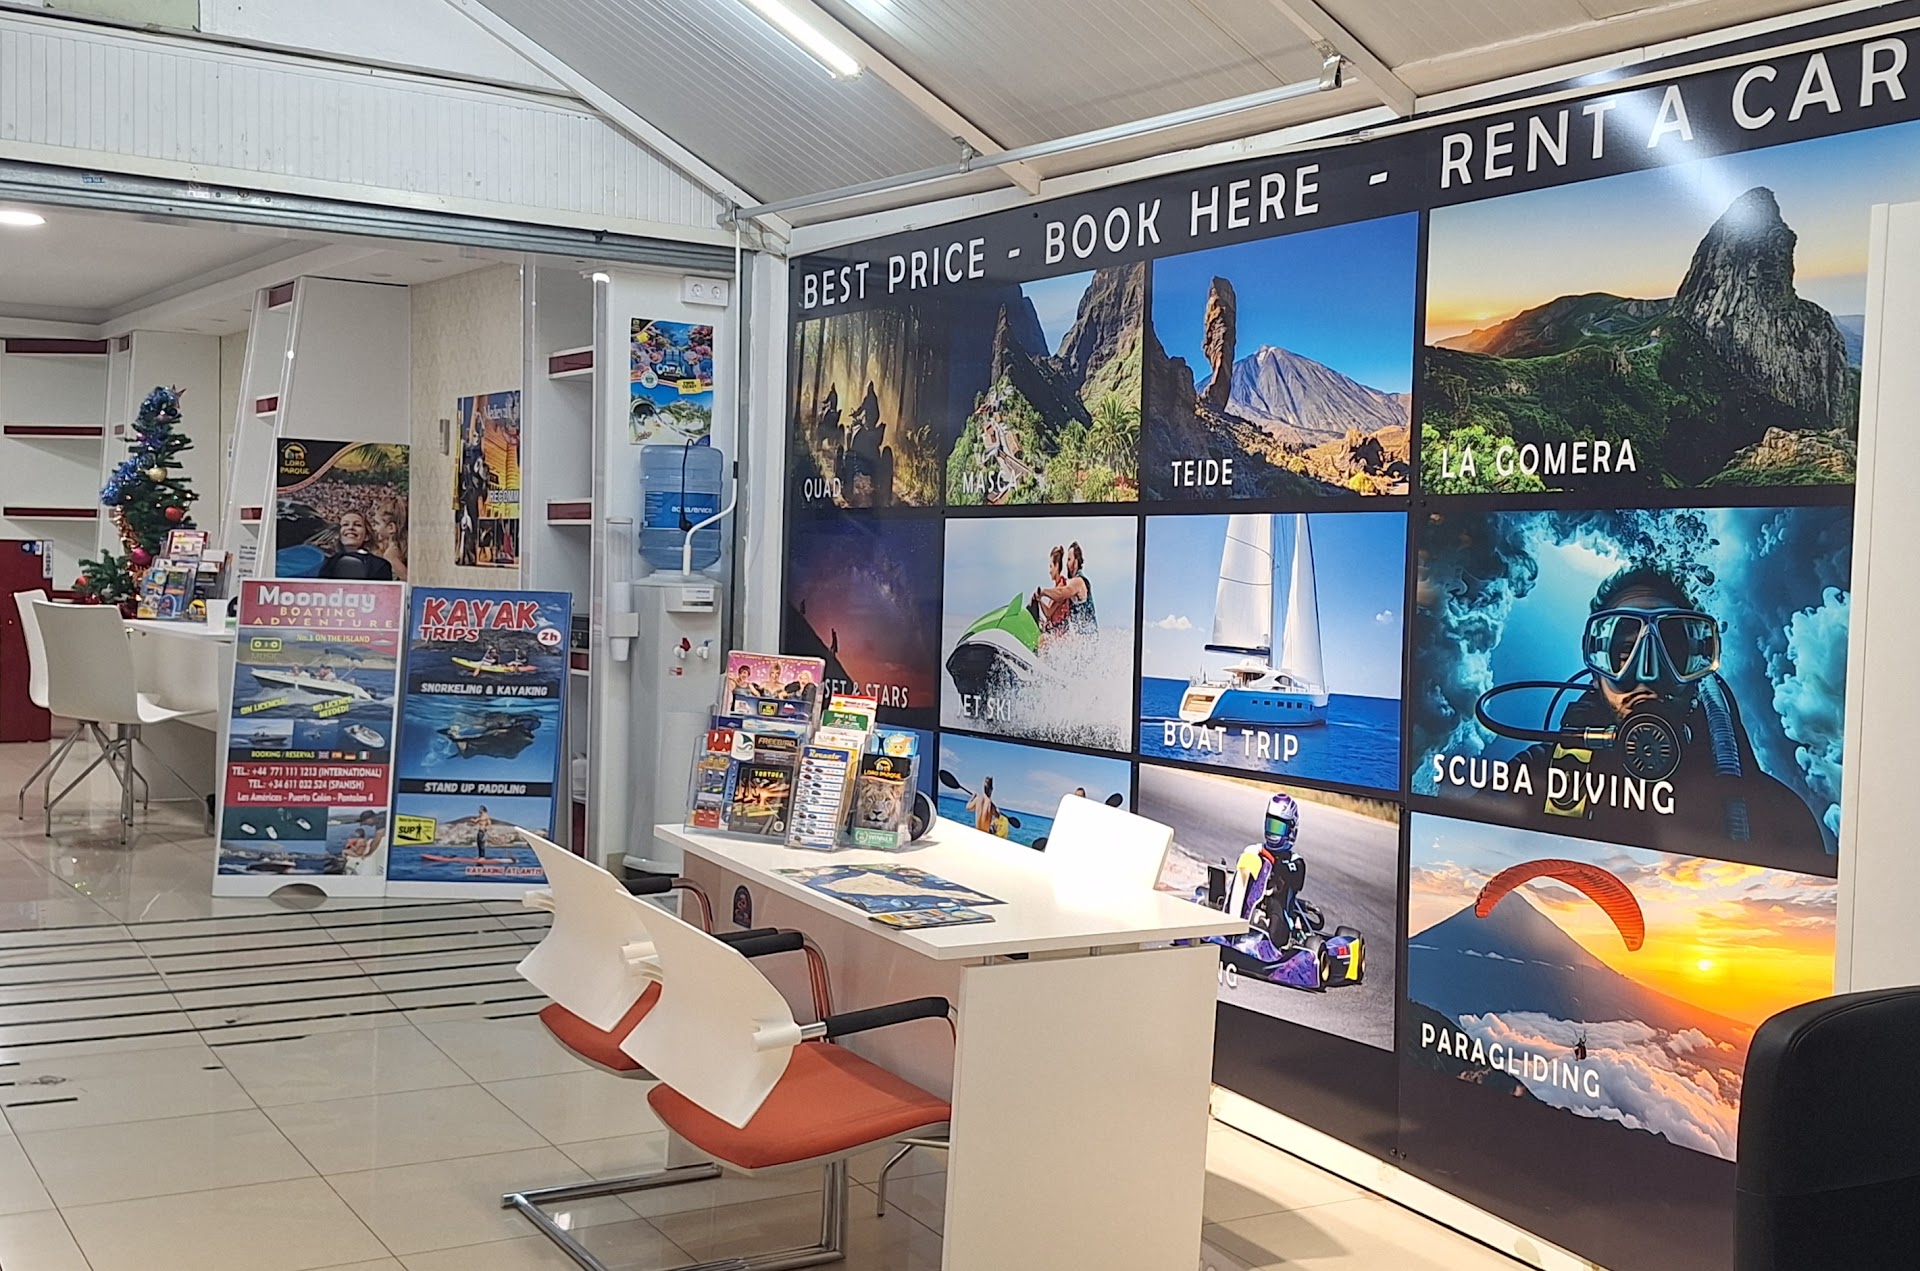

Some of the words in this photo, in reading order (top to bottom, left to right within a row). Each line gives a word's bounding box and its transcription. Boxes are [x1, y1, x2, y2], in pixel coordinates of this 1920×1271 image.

[804, 261, 868, 309] BEST
[888, 238, 985, 294] PRICE
[1045, 200, 1161, 264] BOOK
[1190, 163, 1320, 237] HERE
[1440, 99, 1617, 189] RENT
[1647, 84, 1695, 149] A
[1731, 38, 1909, 131] CAR
[1441, 446, 1477, 478] LA
[1496, 438, 1637, 477] GOMERA
[279, 467, 310, 475] PARQUE
[1171, 459, 1233, 487] TEIDE
[803, 477, 843, 499] QUAD
[962, 470, 1019, 495] MASCA
[258, 585, 376, 613] Moonday
[280, 607, 356, 618] BOATING
[422, 597, 539, 630] KAYAK
[253, 617, 393, 628] ADVENTURE
[343, 635, 370, 643] ISLAND
[419, 626, 480, 642] TRIPS
[541, 631, 558, 642] 2h
[251, 652, 280, 661] MUSIC
[421, 682, 482, 694] SNORKELING
[486, 685, 493, 694] &
[497, 685, 548, 696] KAYAKING
[866, 682, 908, 709] STARS
[957, 692, 980, 718] JET
[986, 696, 1011, 722] SKI
[1163, 720, 1226, 753] BOAT
[1241, 729, 1298, 763] TRIP
[285, 751, 315, 759] RESERVAS
[232, 766, 250, 776] TEL.:
[252, 767, 267, 776] +44
[270, 767, 283, 776] 771
[285, 767, 298, 776] 111
[300, 767, 317, 776] 1213
[318, 767, 382, 779] (INTERNATIONAL)
[248, 779, 266, 789] TEL.:
[268, 780, 283, 789] +34
[284, 780, 297, 789] 611
[299, 780, 312, 789] 032
[313, 780, 327, 789] 524
[328, 780, 364, 790] (SPANISH)
[424, 782, 458, 793] STAND
[460, 783, 474, 793] UP
[477, 784, 527, 795] PADDLING
[1433, 753, 1533, 796] SCUBA
[1548, 766, 1675, 815] DIVING
[237, 792, 249, 801] Las
[288, 793, 310, 802] Puerto
[369, 793, 374, 802] 4
[398, 825, 415, 834] SUP
[466, 866, 505, 876] KAYAKING
[1421, 1022, 1600, 1099] PARAGLIDING
